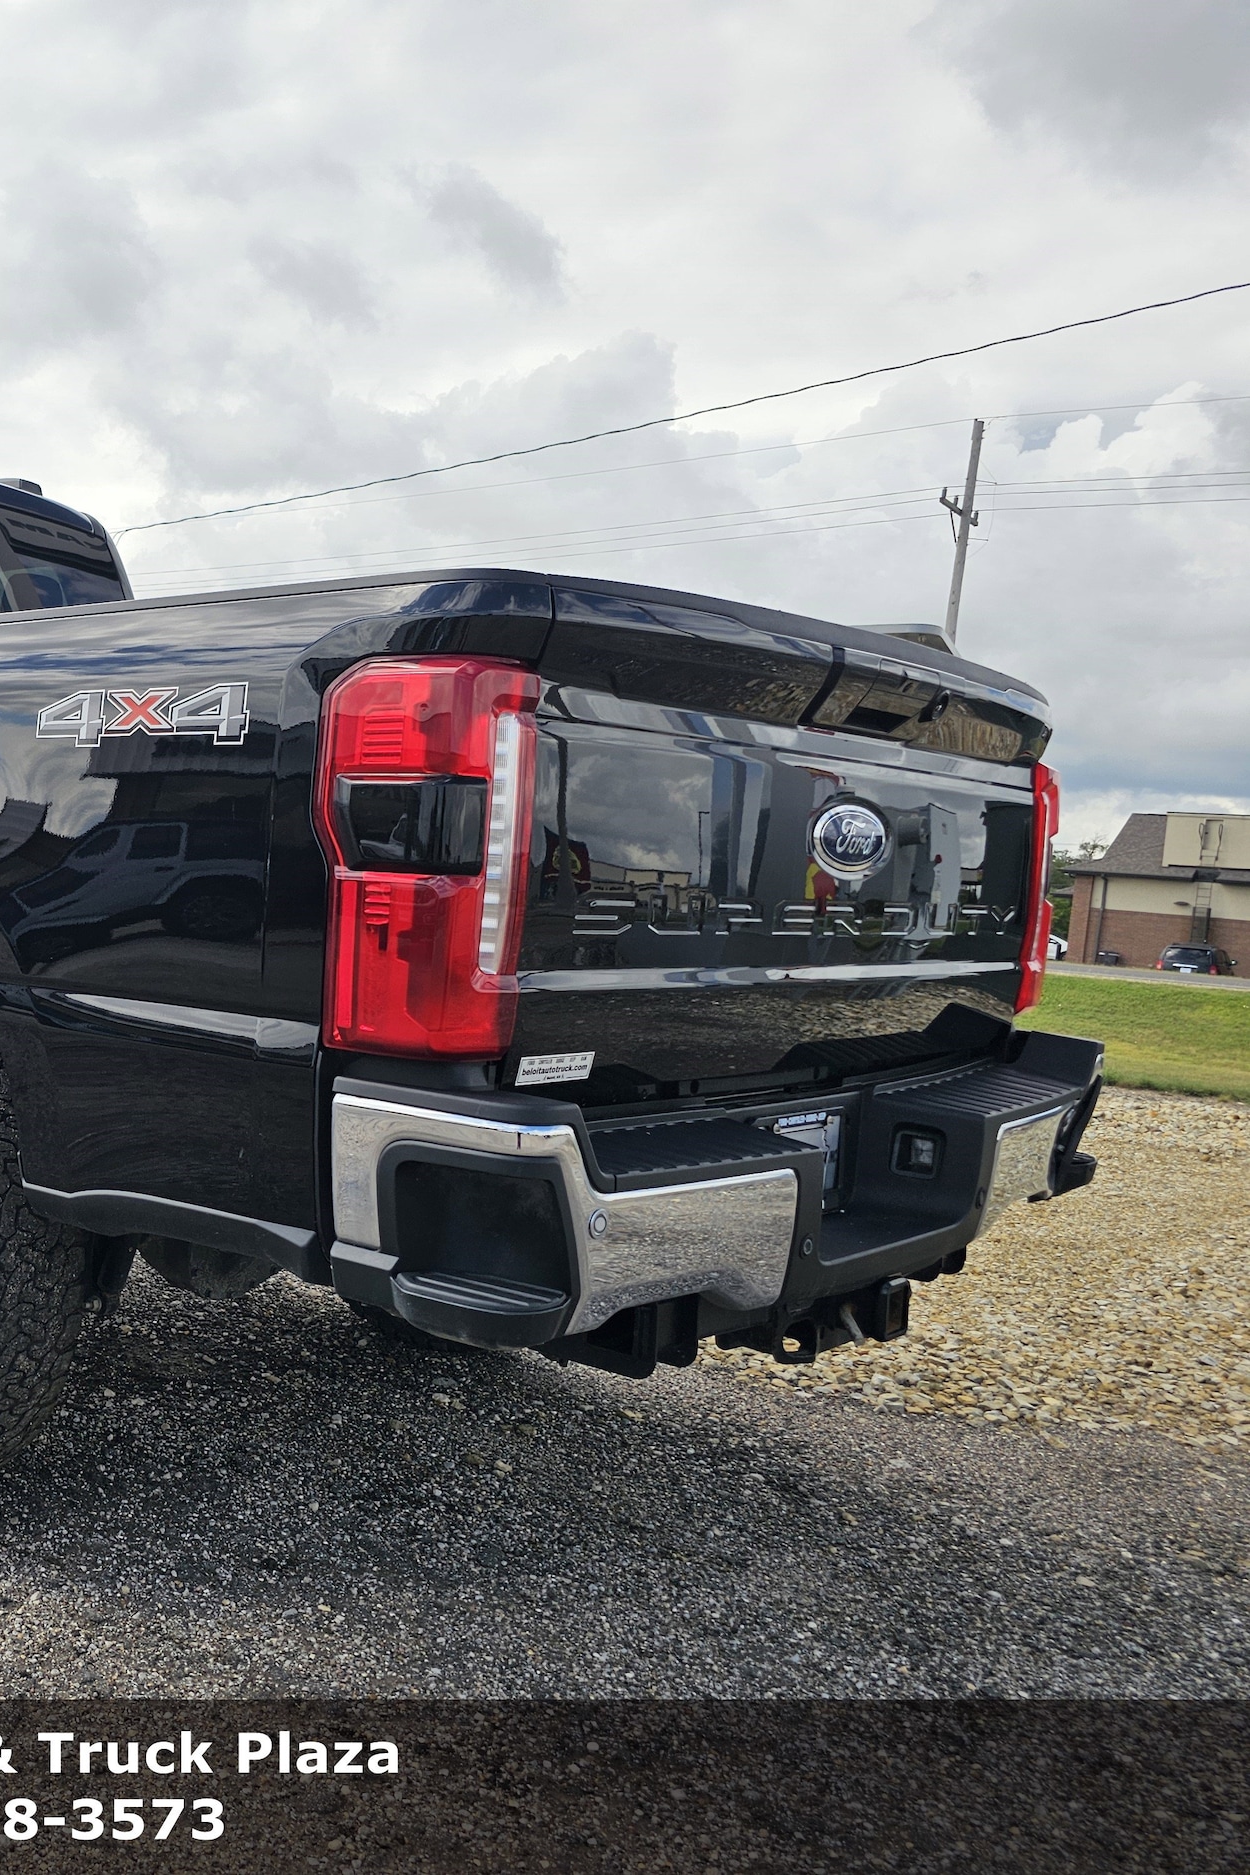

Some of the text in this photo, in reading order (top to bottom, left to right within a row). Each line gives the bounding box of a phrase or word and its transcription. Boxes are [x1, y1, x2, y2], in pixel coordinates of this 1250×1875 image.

[836, 818, 876, 855] Ford
[572, 899, 1016, 936] SUPER DUTY
[521, 1064, 588, 1076] beloitautotruck.com
